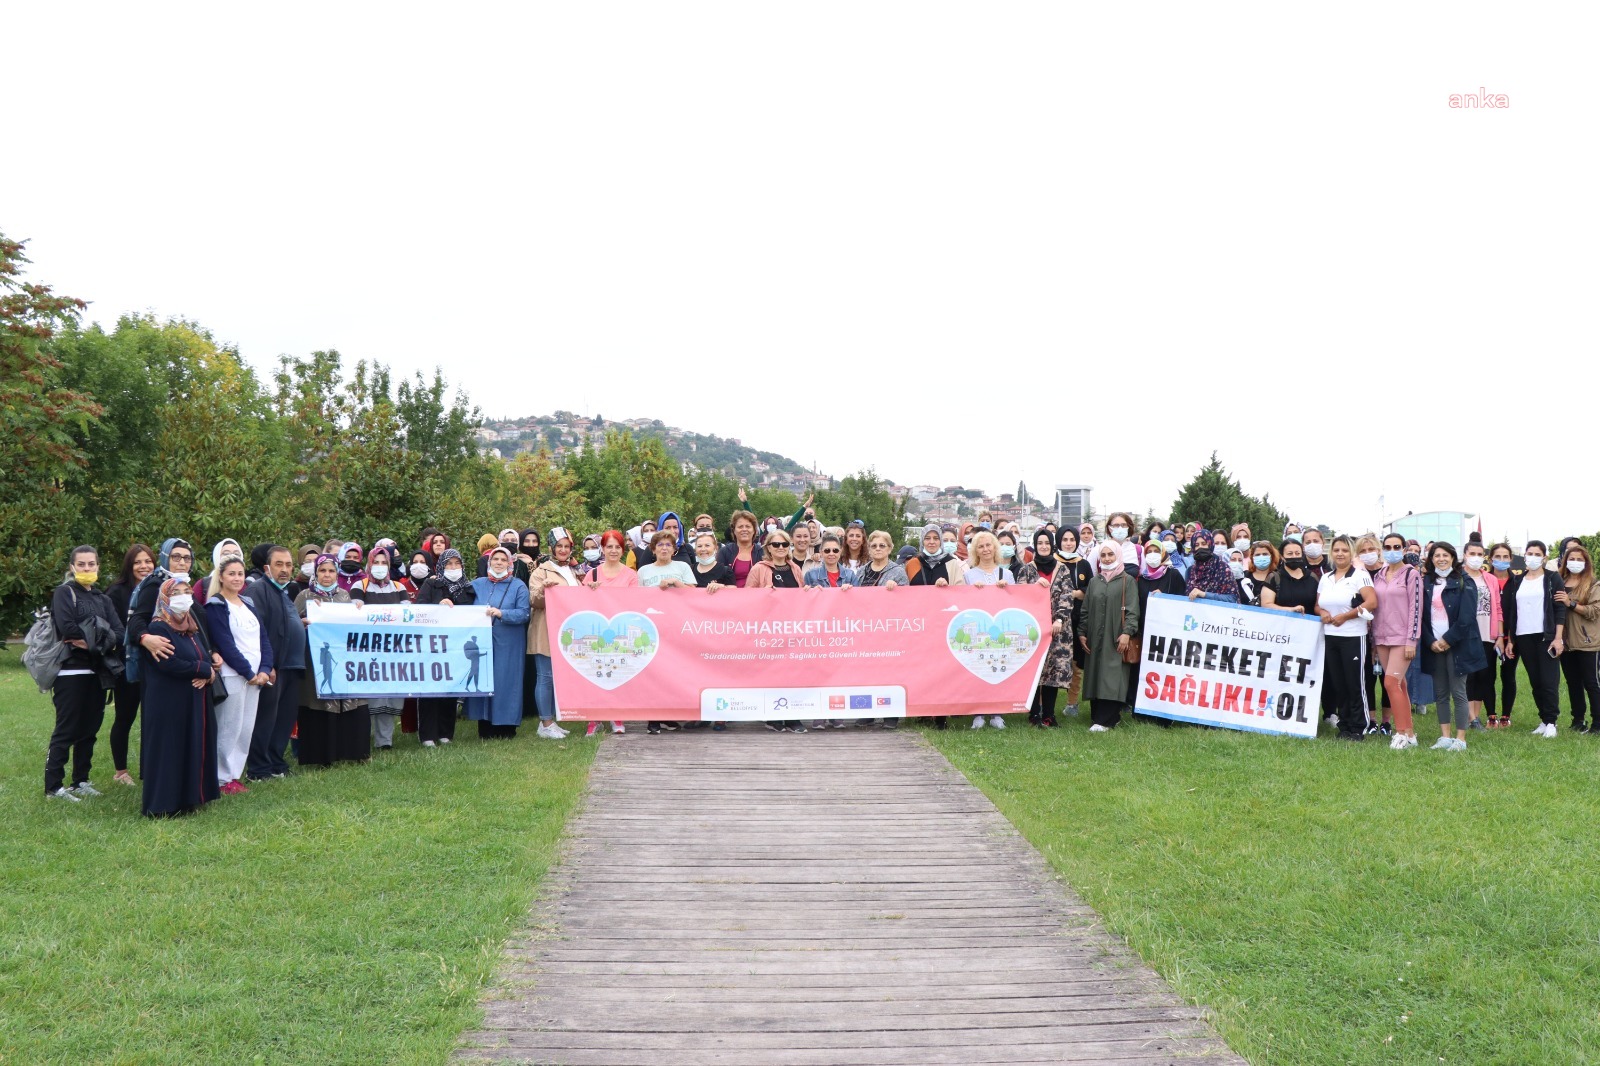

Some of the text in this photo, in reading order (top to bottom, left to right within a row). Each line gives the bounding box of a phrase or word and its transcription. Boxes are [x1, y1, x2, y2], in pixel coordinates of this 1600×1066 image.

[1201, 621, 1291, 645] İZMİT BELEDİYESİ
[1231, 616, 1247, 627] T.C.
[347, 632, 449, 654] HAREKET ET
[753, 635, 855, 648] 16-22 EYLÜL 2021
[828, 650, 858, 658] Güvenli
[1147, 634, 1316, 689] HAREKET ET,
[345, 657, 454, 682] SAĞLIKLI OL
[1276, 692, 1308, 724] OL
